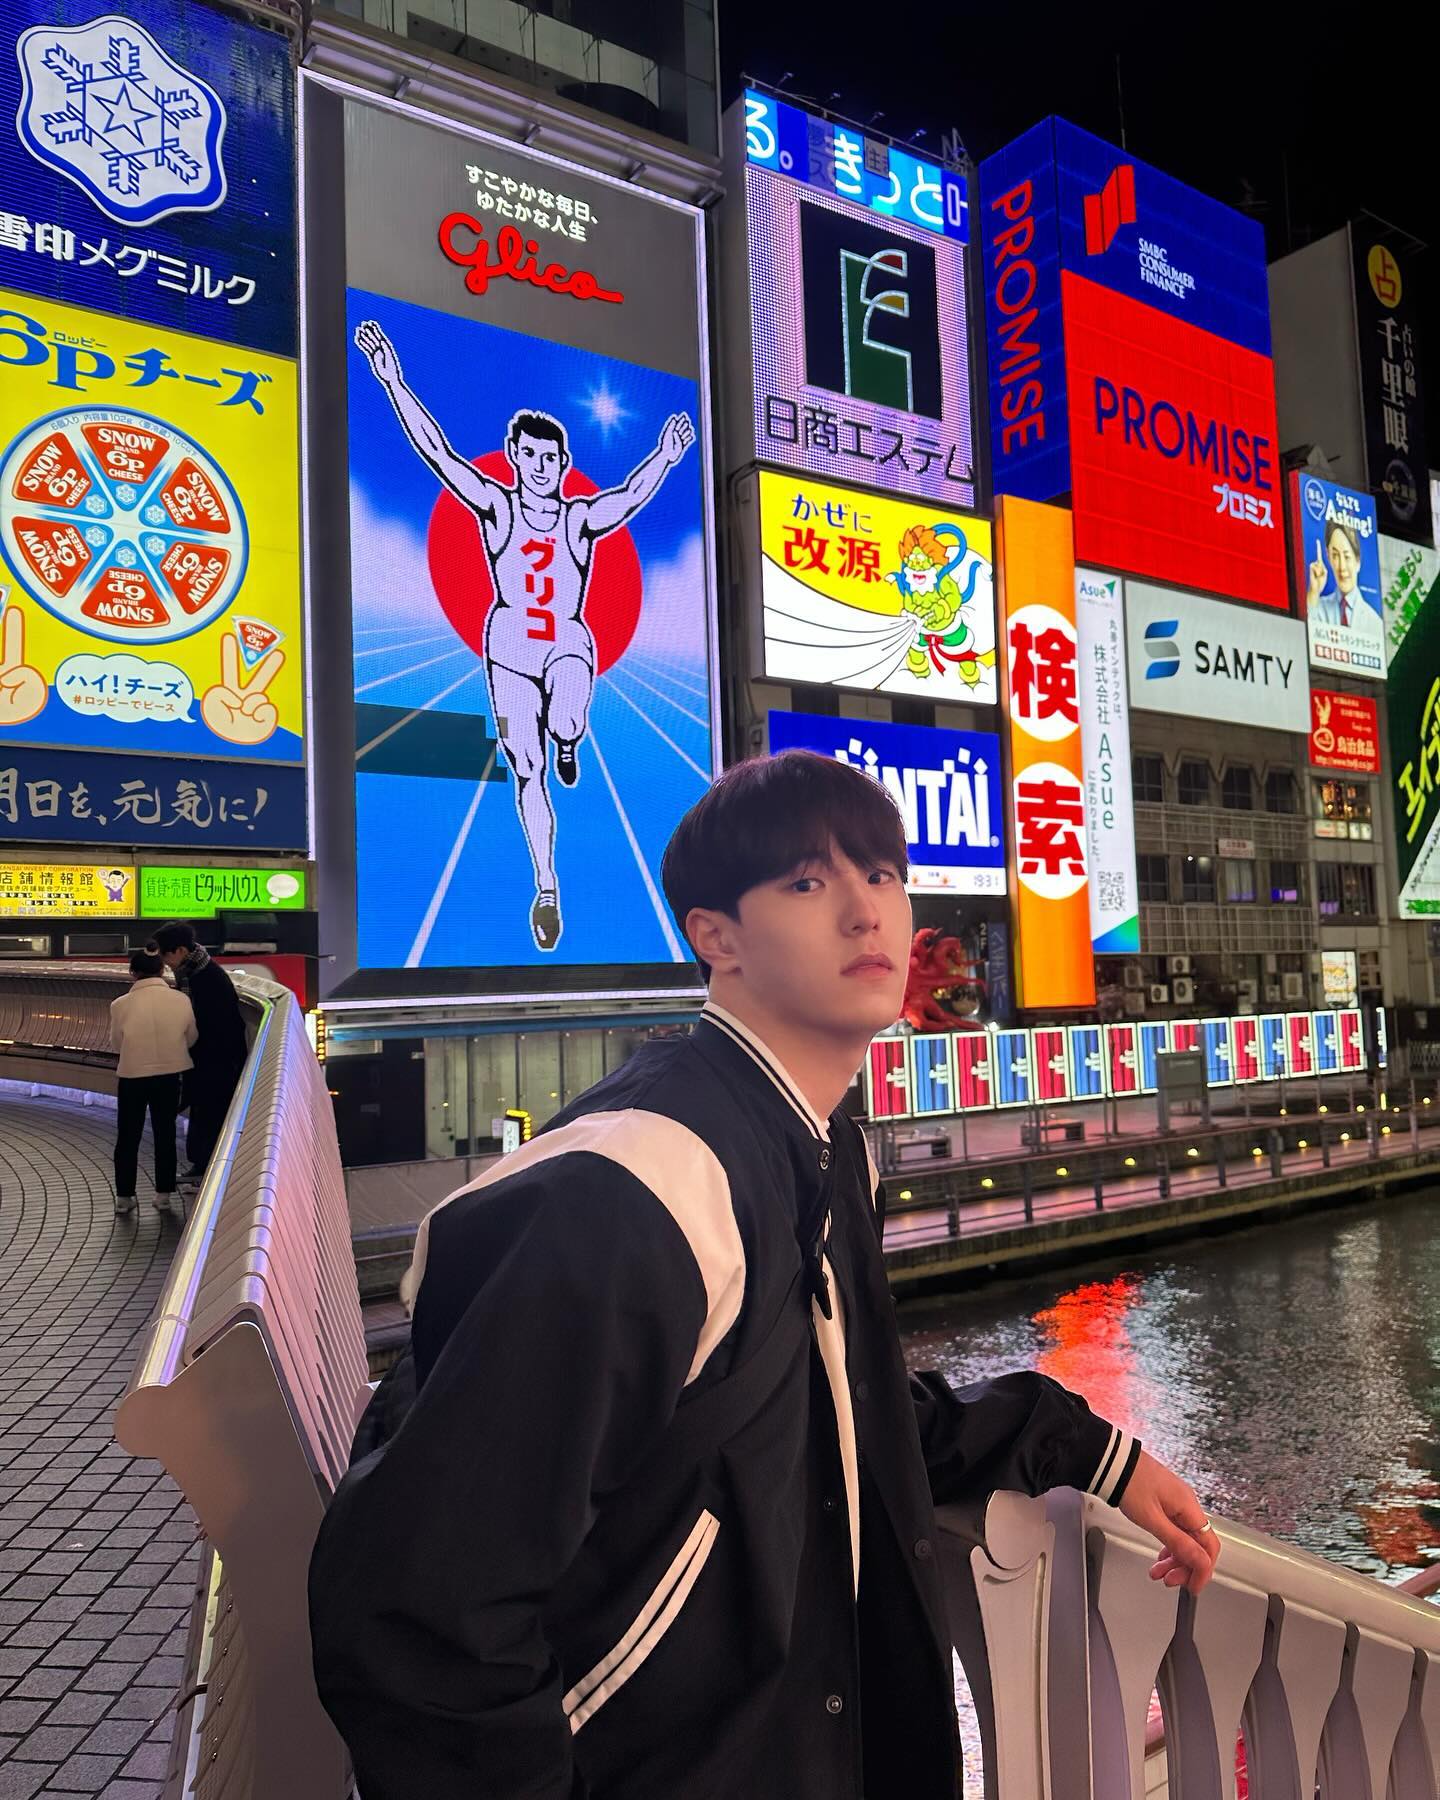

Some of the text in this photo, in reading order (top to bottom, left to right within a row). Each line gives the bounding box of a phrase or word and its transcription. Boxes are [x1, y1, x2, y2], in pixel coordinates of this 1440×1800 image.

[465, 164, 599, 225] すこやかな毎日、
[476, 190, 588, 242] ゆたかな人生
[0, 211, 256, 305] 雪印メグミルク
[438, 212, 625, 303] Glico
[1139, 238, 1168, 263] SMBC
[1139, 253, 1196, 291] CONSUMER
[1140, 268, 1186, 299] FINANCE
[991, 179, 1045, 455] PROMISE
[54, 331, 107, 348] ロッピー
[98, 428, 156, 451] SNOW
[766, 395, 974, 485] 日商エステム
[1093, 375, 1272, 491] PROMISE
[22, 440, 63, 492] SNOW
[106, 450, 145, 472] 6P
[108, 468, 144, 482] CHEESE
[48, 467, 78, 497] 6P
[65, 477, 90, 506] CHEESE
[186, 471, 225, 521] SNOW
[162, 492, 184, 524] CHEESE
[174, 486, 196, 521] 6P
[792, 493, 872, 534] かぜに
[1212, 481, 1275, 529] プロミス
[1325, 499, 1373, 538] Asking!
[19, 530, 63, 583] SNOW
[52, 530, 77, 567] 6P
[65, 527, 89, 560] CHEESE
[162, 544, 184, 572] CHEESE
[783, 525, 882, 584] 改源
[108, 570, 144, 582] CHEESE
[174, 552, 200, 581] 6P
[188, 557, 223, 606] SNOW
[107, 580, 146, 601] 6P
[520, 537, 557, 641] グリコ
[1080, 581, 1107, 599] Asue
[96, 602, 154, 622] SNOW
[1195, 640, 1293, 689] SAMTY
[1010, 622, 1088, 876] 検索
[0, 871, 94, 886] 店舗情報館
[195, 873, 261, 903] ピタットハウス
